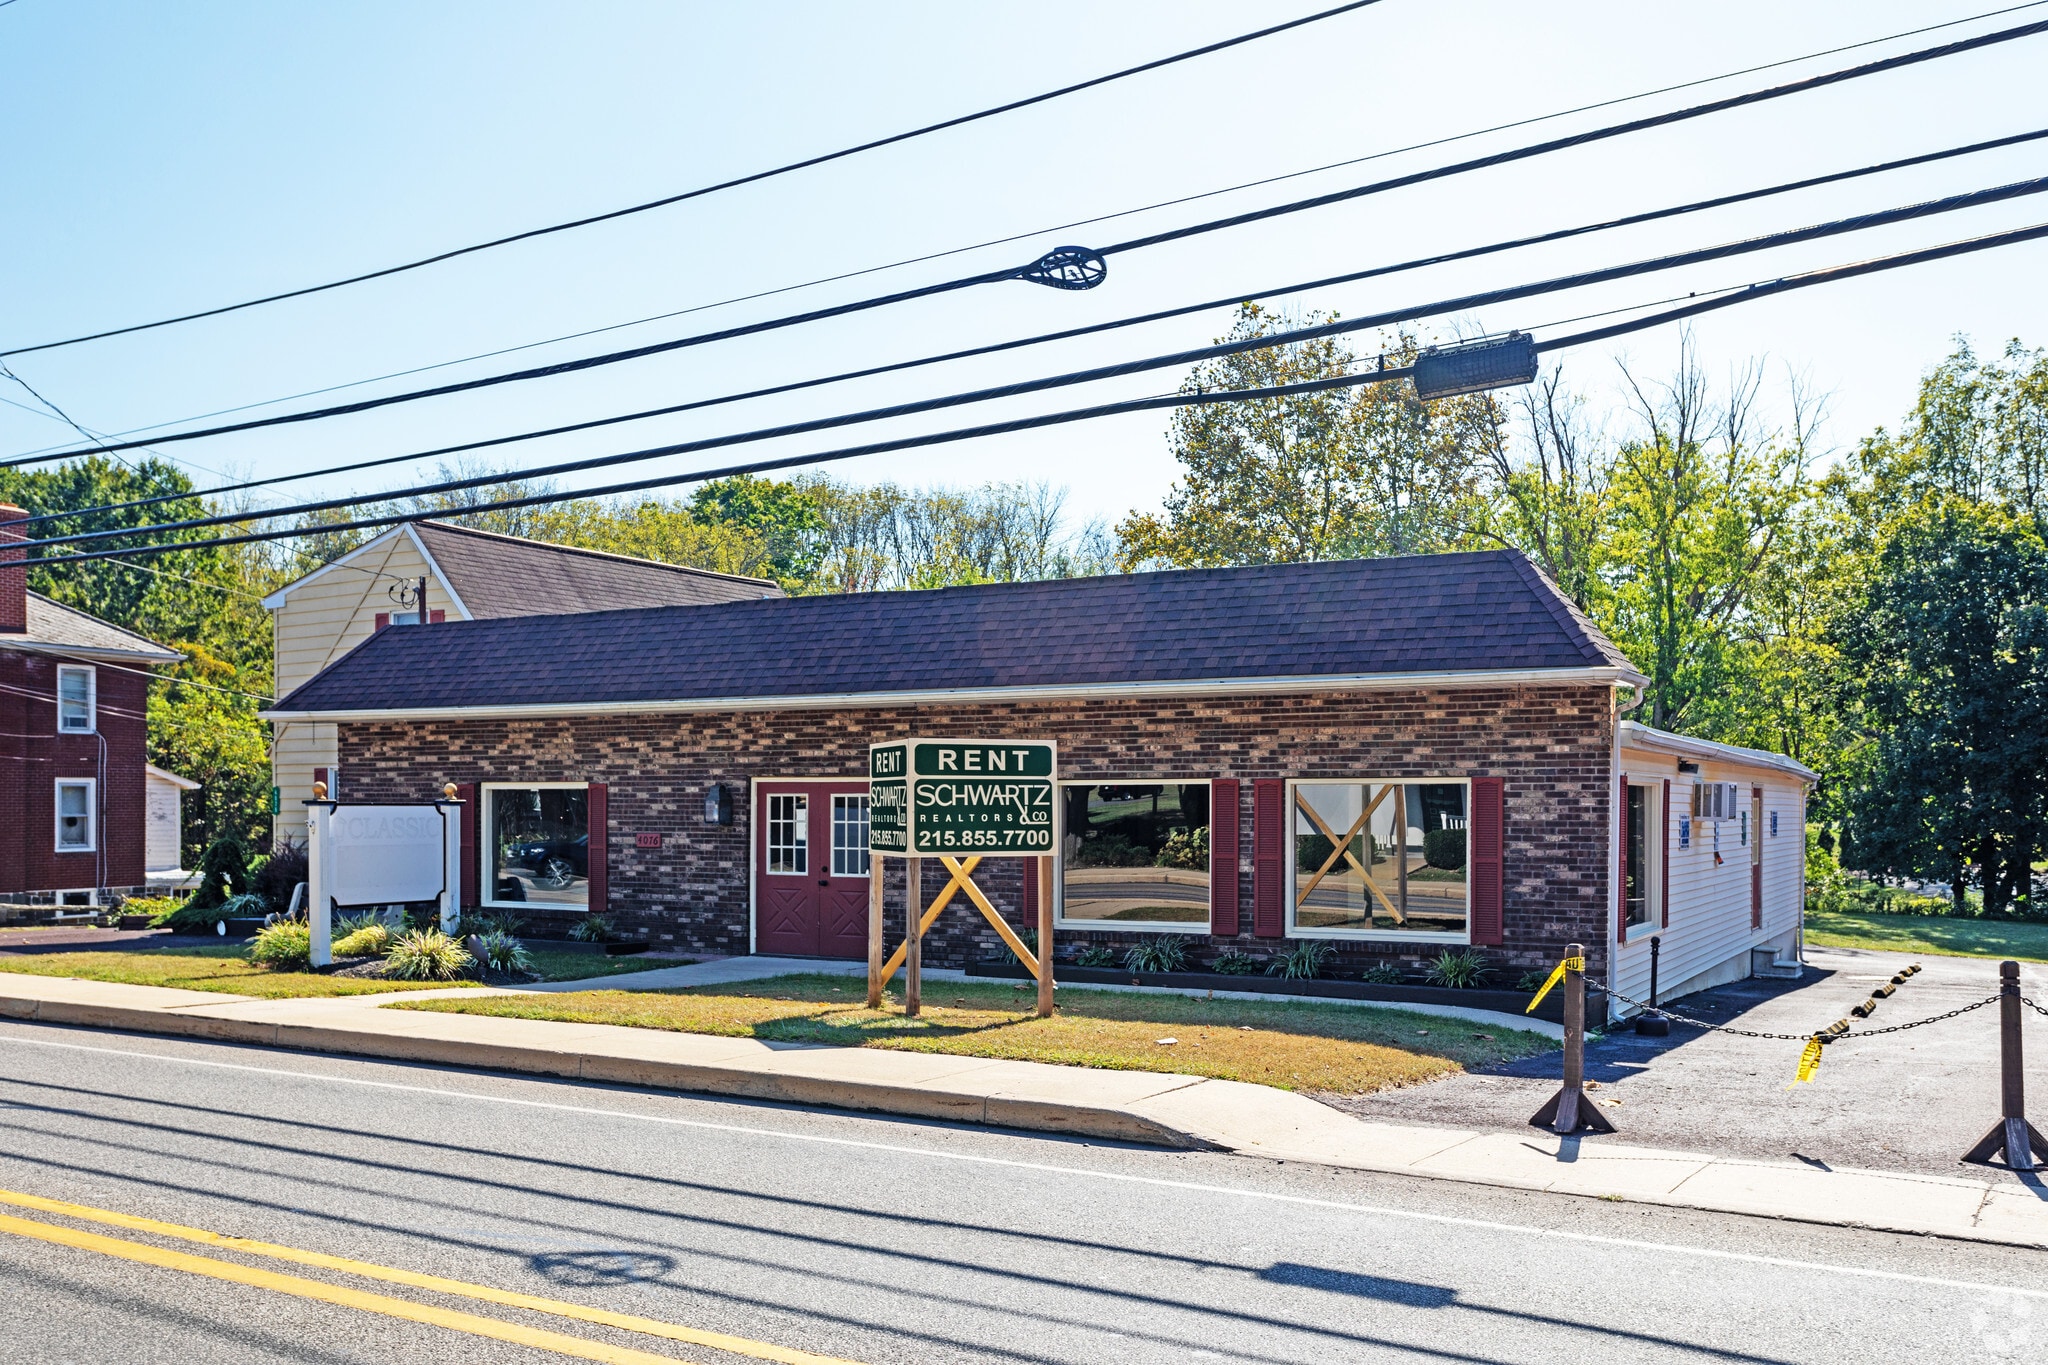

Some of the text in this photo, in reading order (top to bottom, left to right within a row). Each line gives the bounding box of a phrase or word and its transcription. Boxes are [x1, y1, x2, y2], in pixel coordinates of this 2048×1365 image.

[876, 751, 901, 773] RENT
[938, 750, 1030, 771] RENT
[871, 785, 907, 807] SCHWARTZ
[916, 784, 1050, 806] SCHWARTZ
[348, 816, 440, 839] CLASSIC
[872, 814, 897, 823] REALTORS
[920, 813, 1013, 823] REALTORS
[637, 835, 659, 846] 4076
[871, 829, 907, 847] 215.855.7700
[919, 830, 1050, 847] 215.855.7700
